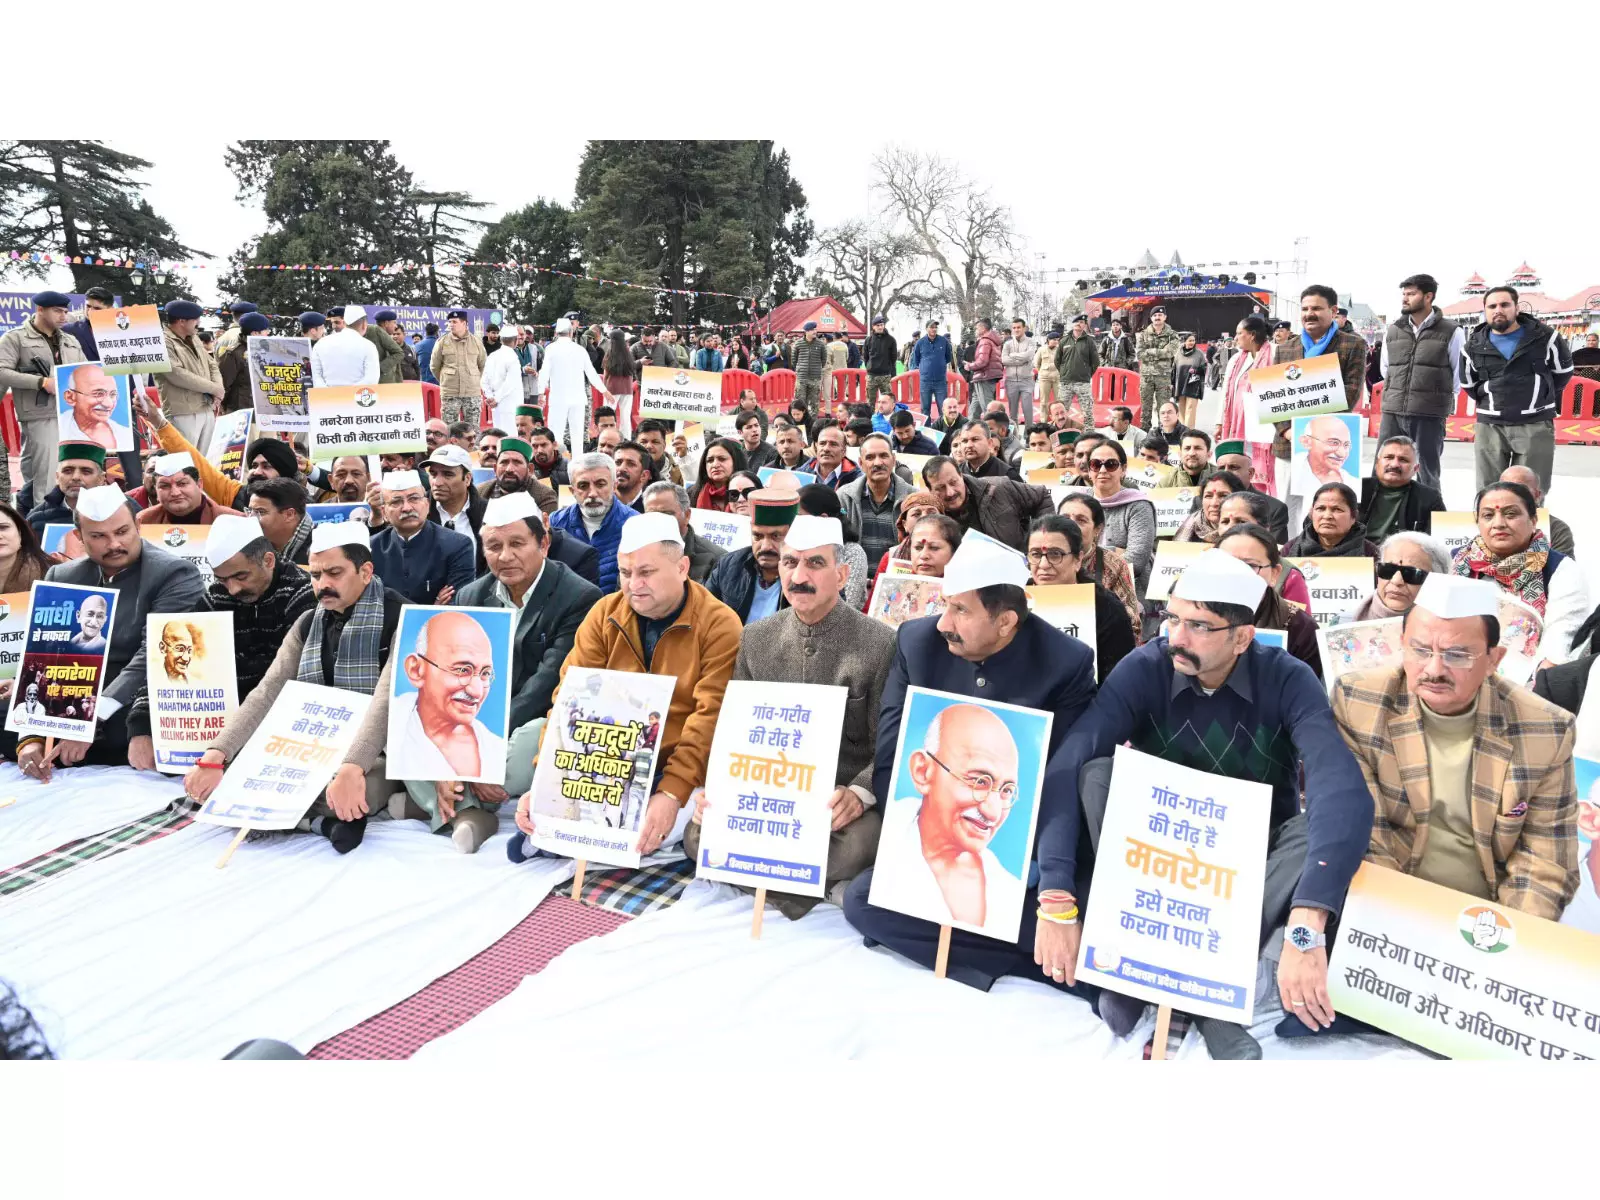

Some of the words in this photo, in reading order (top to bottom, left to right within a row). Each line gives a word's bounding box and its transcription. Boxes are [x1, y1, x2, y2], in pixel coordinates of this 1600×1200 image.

[0, 296, 32, 310] WIN
[264, 363, 302, 383] मजदूरों
[1259, 388, 1286, 402] श्रमिकों
[1287, 387, 1296, 396] के
[1298, 382, 1327, 394] सम्मान
[1328, 378, 1337, 388] में
[643, 399, 660, 408] किसी
[662, 401, 672, 409] की
[1271, 402, 1296, 413] कांग्रेस
[1321, 395, 1330, 404] में
[319, 414, 354, 427] मनरेगा
[355, 414, 383, 425] हमारा
[385, 413, 402, 424] हक
[316, 432, 341, 445] किसी
[343, 431, 357, 443] की
[358, 429, 400, 443] मेहरबानी
[402, 427, 421, 440] नहीं
[33, 600, 75, 626] गांधी
[32, 628, 41, 642] से
[42, 631, 72, 642] नफरत
[45, 662, 98, 681] मनरेगा
[46, 684, 61, 697] पर
[61, 685, 93, 697] हमला
[157, 689, 175, 699] FIRST
[176, 689, 194, 699] THEY
[196, 688, 224, 699] KILLED
[158, 701, 192, 711] MAHATMA
[193, 701, 226, 712] GANDHI
[302, 701, 354, 722] गांव-गरीब
[752, 702, 812, 724] गांव-गरीब
[160, 716, 177, 728] NOW
[178, 717, 202, 728] THEY
[204, 717, 225, 728] ARE
[292, 718, 310, 733] की
[160, 730, 185, 741] KILLING
[185, 730, 199, 741] HIS
[200, 730, 220, 741] NAM
[573, 719, 645, 758] मजदूरों
[748, 726, 766, 745] की
[768, 728, 790, 751] रीढ़
[792, 729, 803, 749] है
[264, 735, 340, 766] मनरेगा
[554, 749, 577, 771] का
[575, 750, 633, 780] अधिकार
[729, 751, 817, 792] मनरेगा
[562, 775, 608, 804] वापिस
[606, 781, 624, 806] दो
[738, 791, 760, 811] इसे
[762, 797, 796, 816] खत्म
[1152, 785, 1228, 821] गांव-गरीब
[727, 815, 765, 835] करना
[767, 820, 790, 838] पाप
[792, 818, 803, 840] है
[1149, 812, 1170, 836] की
[1173, 819, 1202, 848] रीढ़
[1204, 825, 1218, 848] है
[728, 856, 754, 872] हिमाचल
[754, 862, 770, 874] प्रदेश
[791, 867, 812, 880] कमेटी
[1125, 836, 1238, 900] मनरेगा
[1135, 889, 1163, 912] इसे
[1166, 897, 1211, 924] खत्म
[1120, 910, 1170, 940] करना
[1173, 925, 1204, 949] पाप
[1207, 928, 1221, 953] है
[1121, 962, 1157, 984] हिमाचल
[1157, 973, 1178, 990] प्रदेश
[1178, 980, 1207, 997] कांग्रेस
[1207, 986, 1236, 1002] कमेटी
[1348, 928, 1410, 965] मनरेगा
[1414, 951, 1440, 977] पर
[1484, 977, 1548, 1018] मजदूर
[1552, 1000, 1581, 1027] पर
[1584, 1011, 1600, 1034] वा
[1344, 965, 1412, 1008] संविधान
[1415, 994, 1453, 1025] और
[1455, 1012, 1536, 1056] अधिकार
